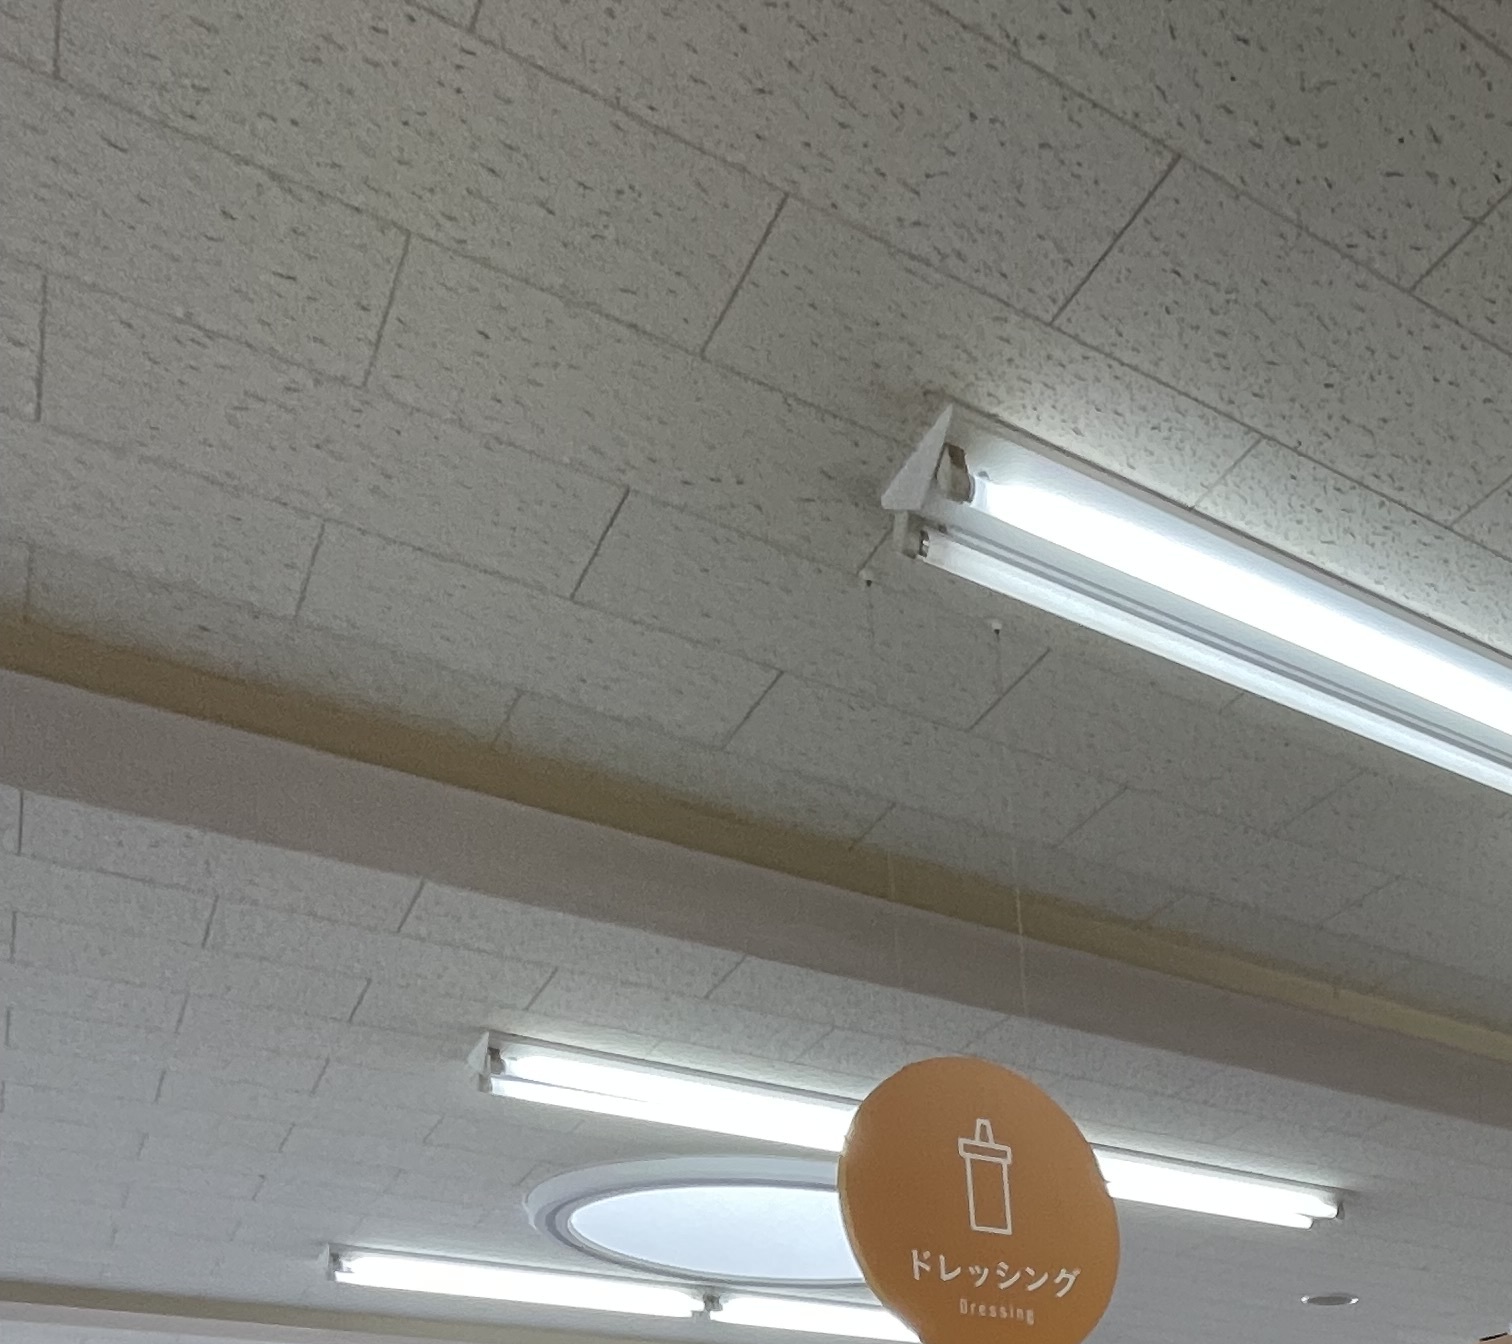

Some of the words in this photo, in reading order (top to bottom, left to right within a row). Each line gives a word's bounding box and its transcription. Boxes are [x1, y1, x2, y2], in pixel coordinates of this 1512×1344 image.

[911, 1249, 1081, 1298] ドレッシング
[959, 1298, 1035, 1325] Dressing
